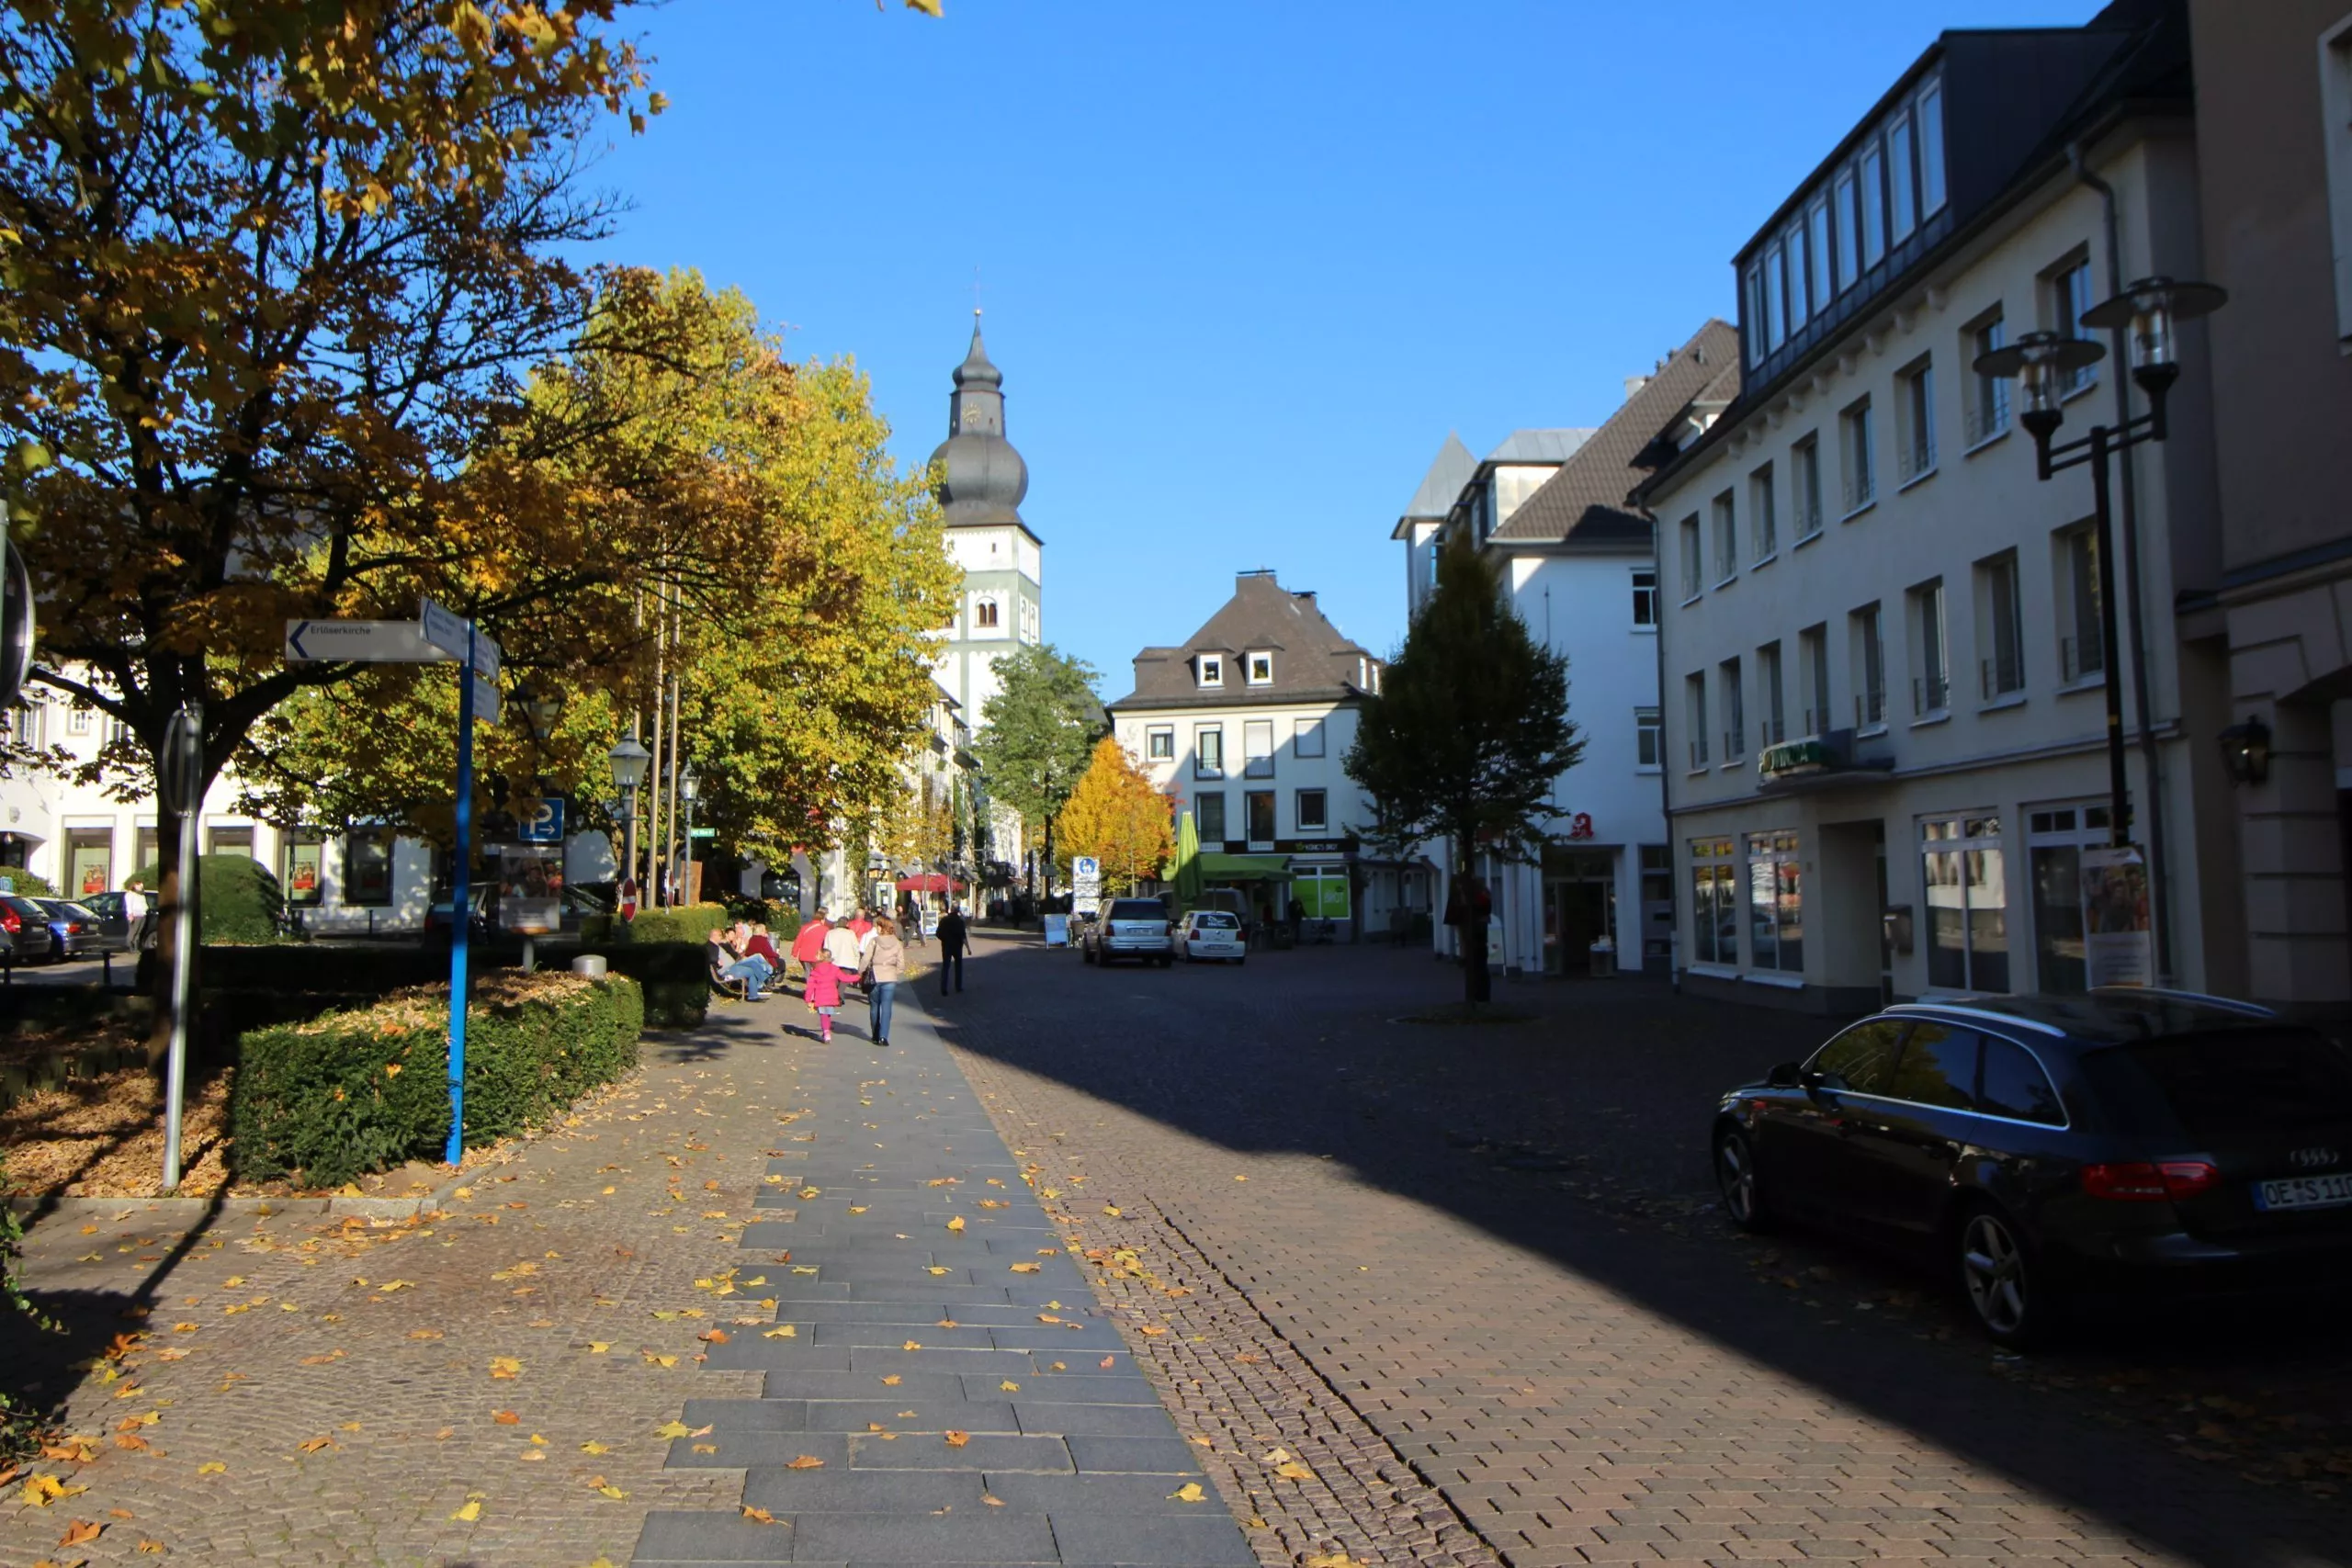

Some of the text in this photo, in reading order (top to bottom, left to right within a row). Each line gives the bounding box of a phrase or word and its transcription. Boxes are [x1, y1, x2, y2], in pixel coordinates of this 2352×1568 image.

[311, 625, 371, 635] Erlöserkirche
[2265, 1182, 2294, 1204] OE
[2304, 1179, 2320, 1201] S
